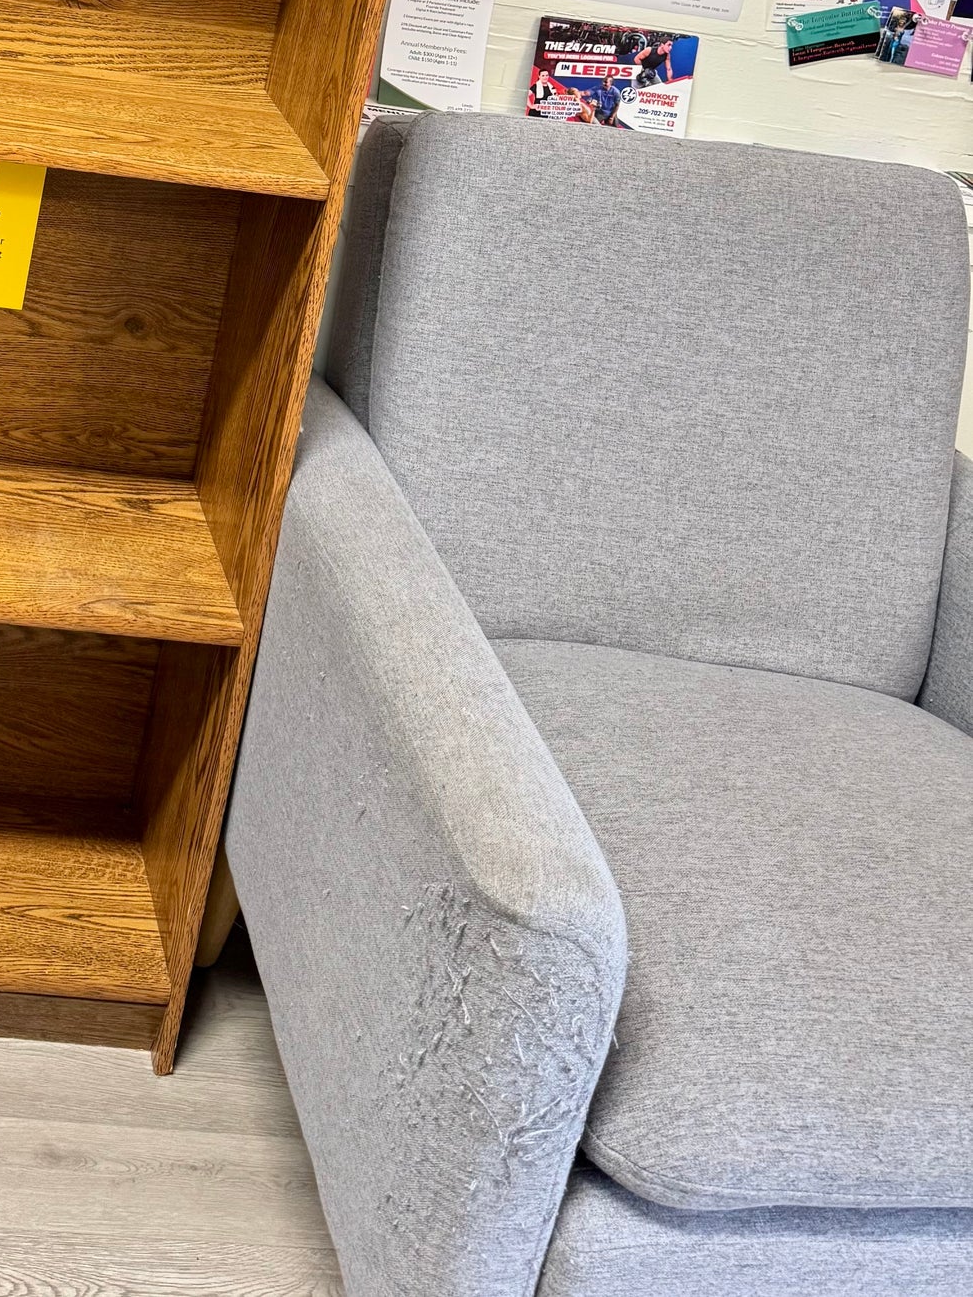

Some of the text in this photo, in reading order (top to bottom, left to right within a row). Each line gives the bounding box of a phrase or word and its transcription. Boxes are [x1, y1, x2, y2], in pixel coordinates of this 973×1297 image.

[544, 40, 617, 55] THE 24/7 GYM
[570, 64, 633, 77] LEEDS
[637, 90, 679, 102] WORKOUT
[639, 97, 676, 108] ANYTIME
